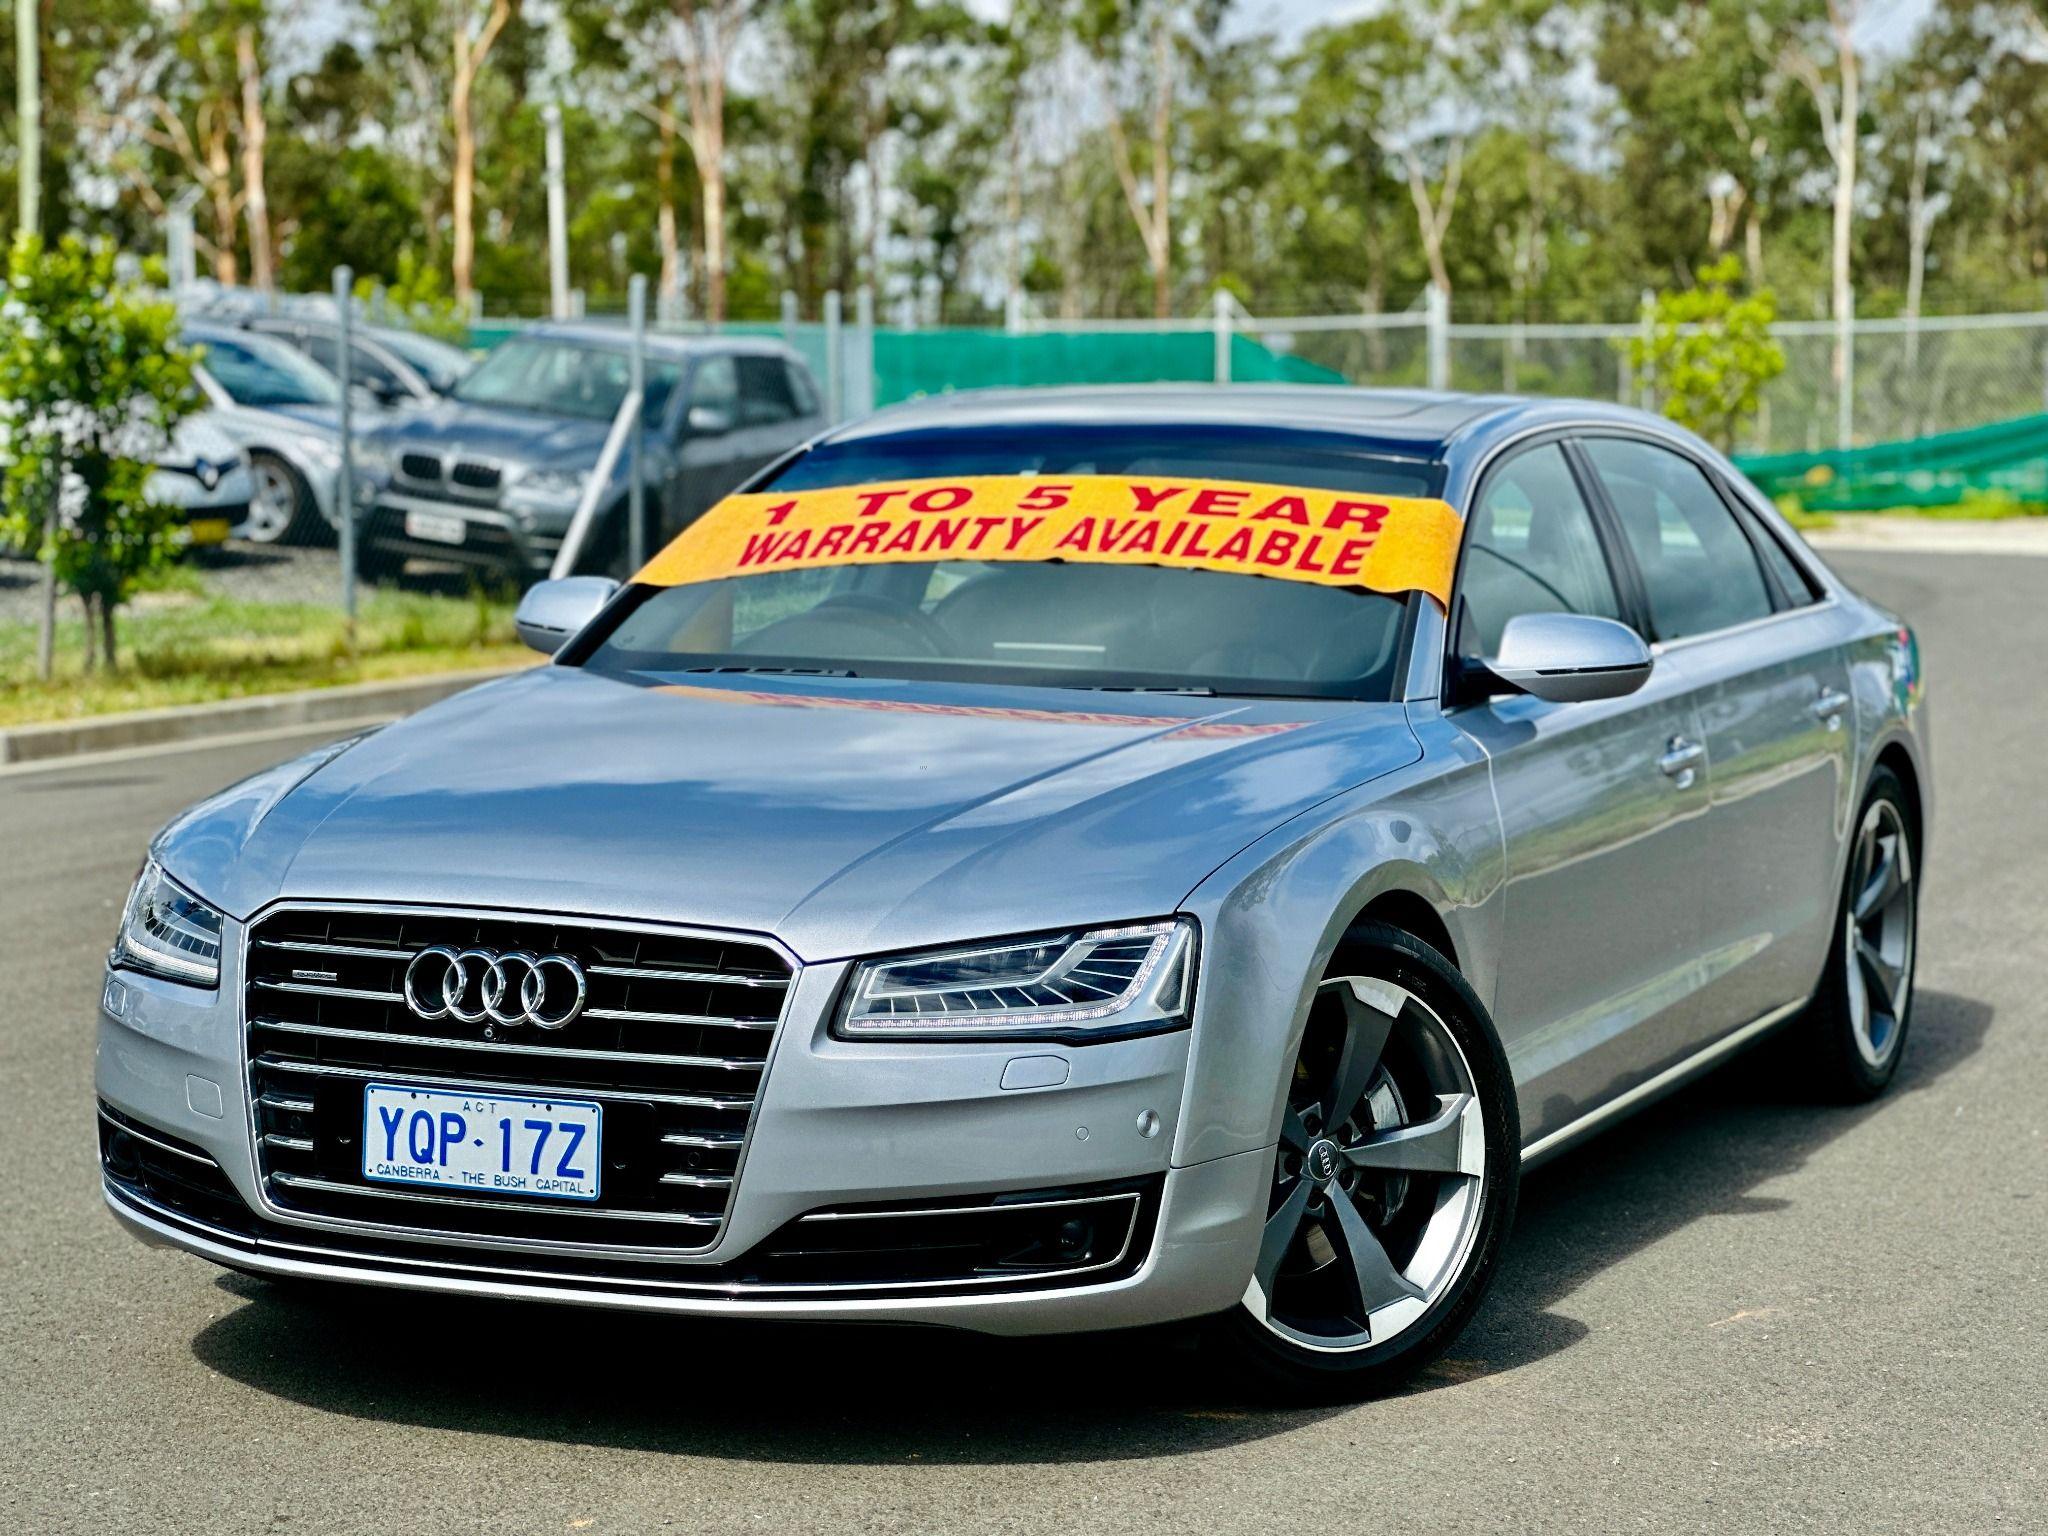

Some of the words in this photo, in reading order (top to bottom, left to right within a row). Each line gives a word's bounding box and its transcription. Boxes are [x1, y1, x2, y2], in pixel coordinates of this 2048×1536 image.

[766, 500, 798, 526] 1
[857, 486, 974, 517] TO
[1017, 486, 1074, 511] 5
[1130, 486, 1390, 534] YEAR
[737, 517, 1045, 567] WARRANTY
[1055, 517, 1375, 576] AVAILABLE
[463, 1101, 497, 1113] ACT
[376, 1164, 440, 1181] CANBERRA
[461, 1171, 486, 1185] THE
[493, 1175, 527, 1189] BUSH
[535, 1178, 585, 1194] CAPITAL
